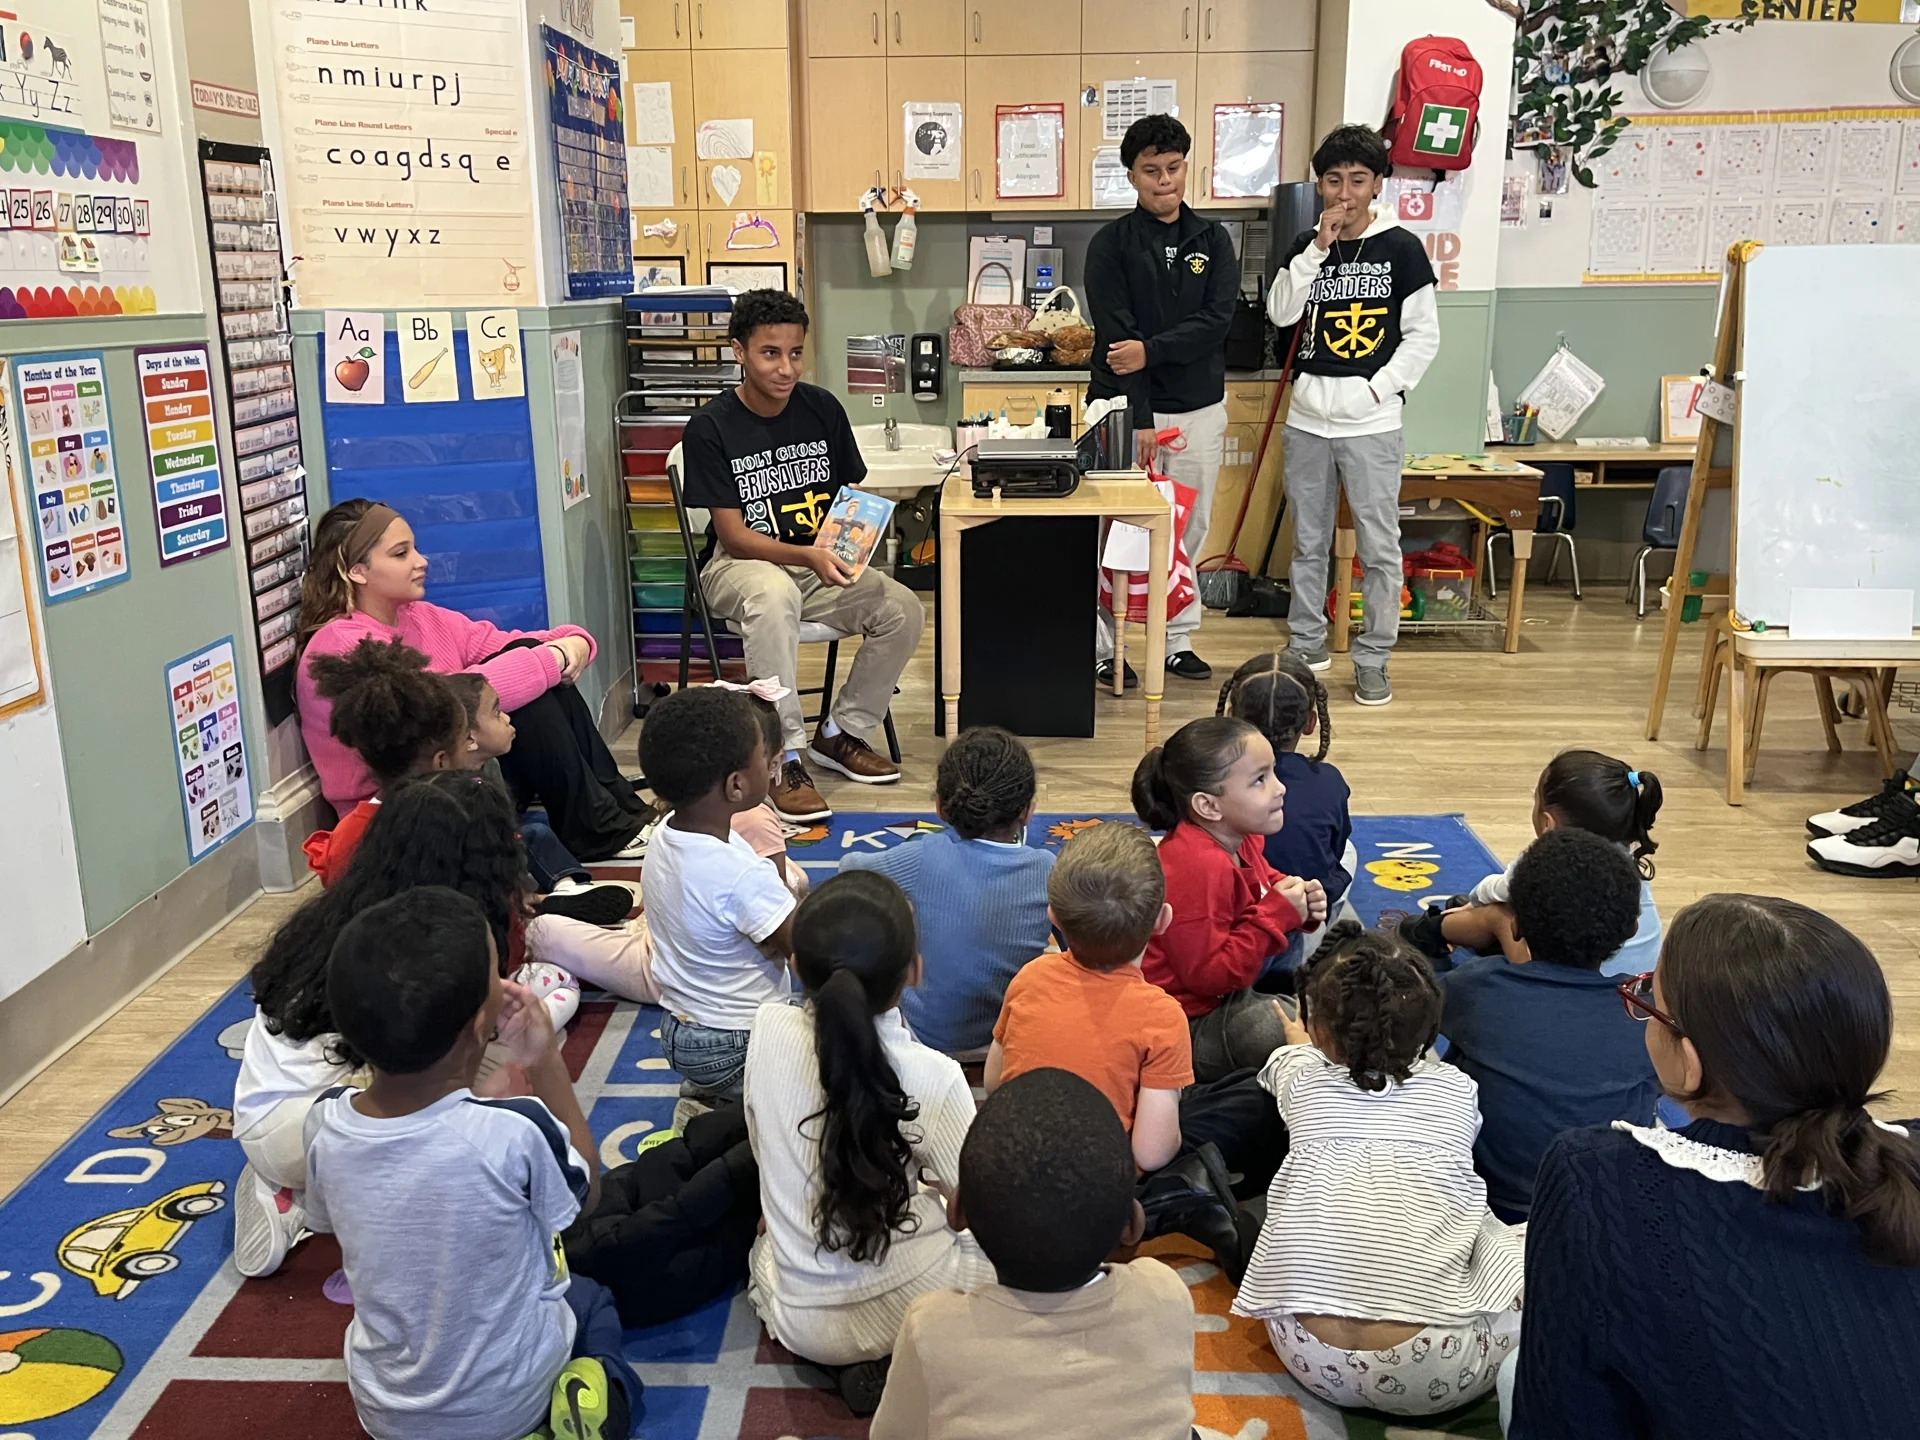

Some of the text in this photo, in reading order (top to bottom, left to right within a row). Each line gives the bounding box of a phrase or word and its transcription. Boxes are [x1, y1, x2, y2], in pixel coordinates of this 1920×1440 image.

[306, 37, 380, 50] Plane Line Letters
[318, 66, 461, 106] n m i u r p j
[195, 87, 225, 107] TODAY'S
[314, 119, 412, 132] Plane Line Round Letters
[485, 128, 511, 137] Special
[327, 138, 510, 183] c o a g d s q e
[1009, 152, 1048, 160] odifications
[322, 199, 414, 210] Plane Line Slide Letters
[13, 199, 29, 219] 25
[35, 200, 51, 221] 26
[59, 203, 70, 222] 27
[77, 204, 92, 223] 28
[96, 205, 112, 224] 29
[117, 206, 130, 225] 30
[136, 208, 145, 227] 31
[335, 227, 441, 258] v w y x z
[1338, 261, 1392, 275] CROSS
[1308, 275, 1393, 303] USADERS
[339, 317, 369, 341] Aa
[412, 317, 439, 341] Bb
[480, 315, 506, 339] Cc
[145, 356, 201, 371] Days of the Week
[24, 365, 97, 381] Months of the Year
[161, 376, 189, 390] Sunday
[164, 403, 192, 416] Monday
[165, 428, 197, 443] Tuesday
[64, 440, 75, 449] May
[164, 453, 205, 470] Wednesday
[731, 440, 828, 474] HOLY CROSS
[170, 478, 205, 495] Thursday
[735, 456, 830, 503] CRUSADERS
[90, 484, 114, 495] September
[46, 495, 56, 505] July
[178, 504, 203, 519] Friday
[176, 528, 211, 546] Saturday
[192, 658, 210, 672] Colors
[841, 830, 888, 849] K
[65, 1147, 167, 1184] D
